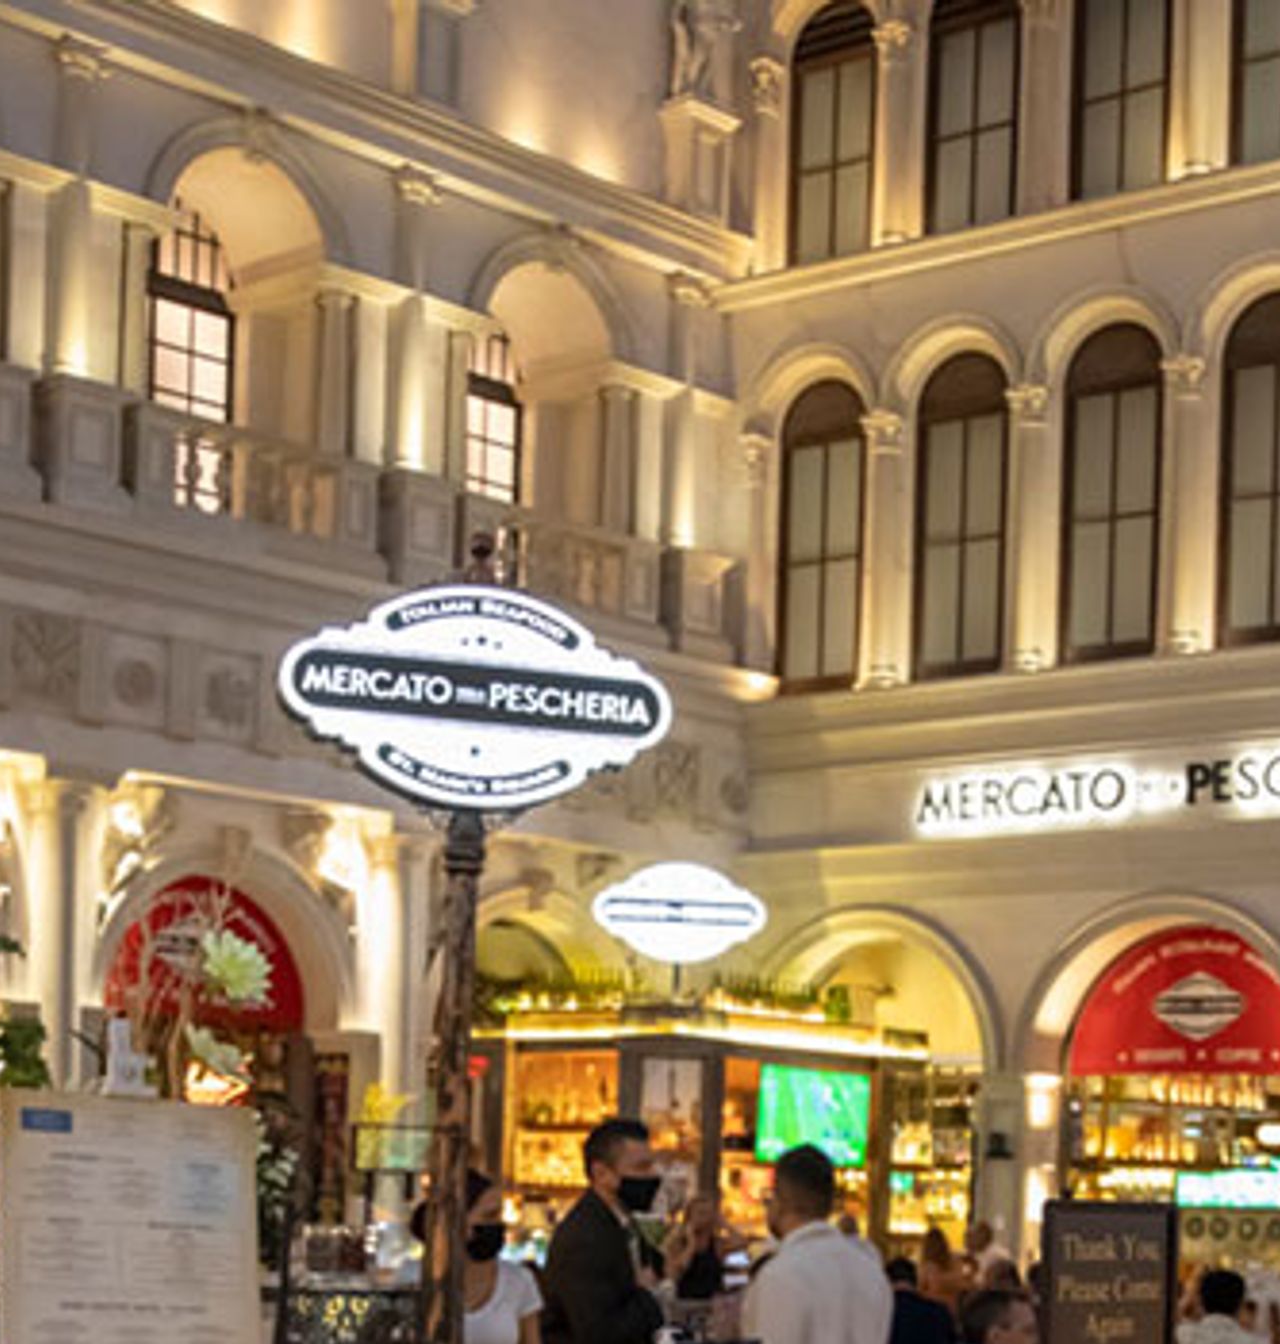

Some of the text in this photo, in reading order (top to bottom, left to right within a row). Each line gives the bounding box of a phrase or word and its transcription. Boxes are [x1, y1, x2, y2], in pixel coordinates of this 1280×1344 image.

[301, 664, 452, 704] MERCATO
[489, 682, 650, 726] PESCHERIA
[917, 769, 1125, 823] MERCATO
[1060, 1232, 1161, 1261] Thank You
[1056, 1274, 1113, 1303] Please
